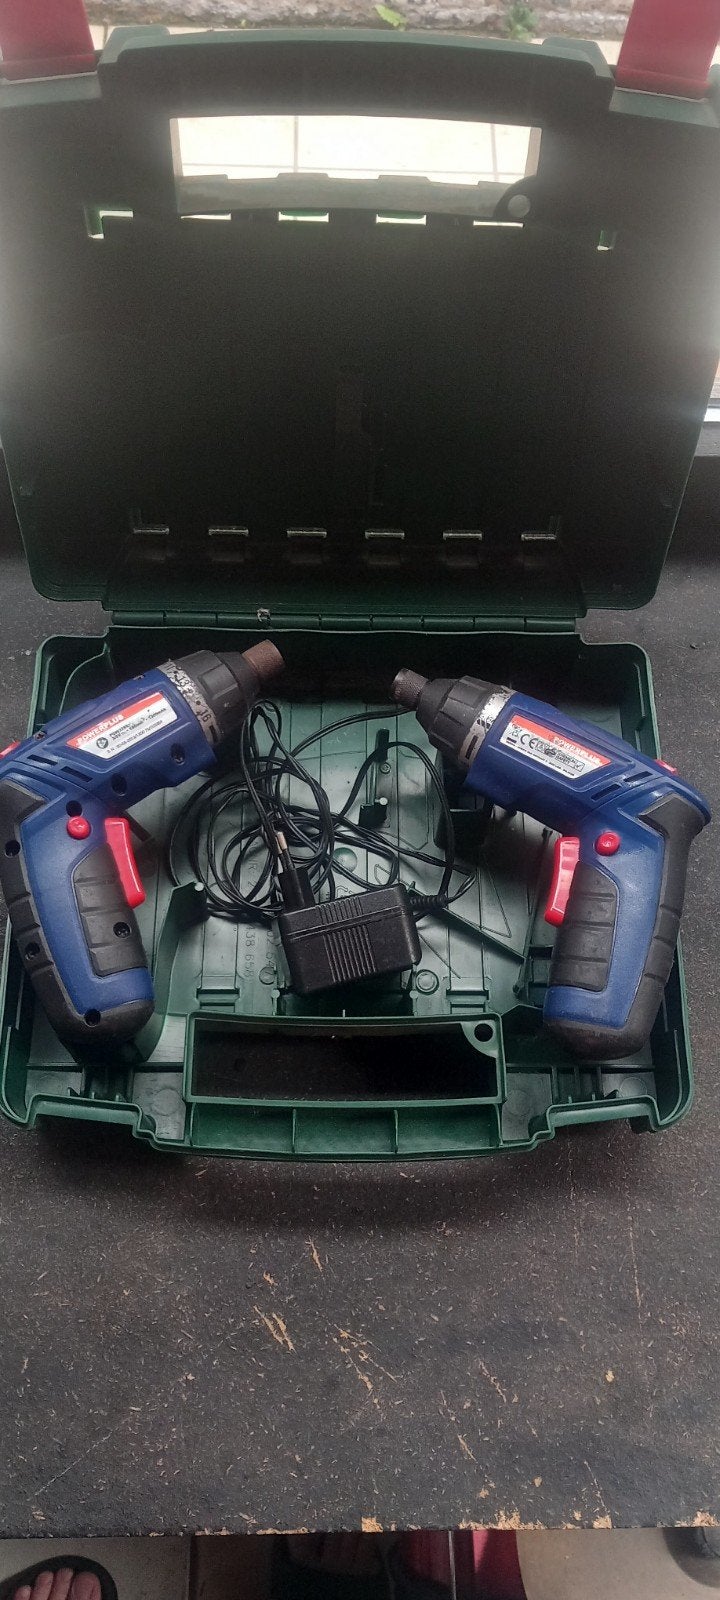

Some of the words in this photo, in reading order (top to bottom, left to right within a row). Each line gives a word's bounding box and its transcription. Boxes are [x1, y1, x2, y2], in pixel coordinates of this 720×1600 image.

[76, 714, 124, 746] POWERPLUS
[200, 709, 211, 722] 16
[553, 736, 602, 766] POWERPLUS
